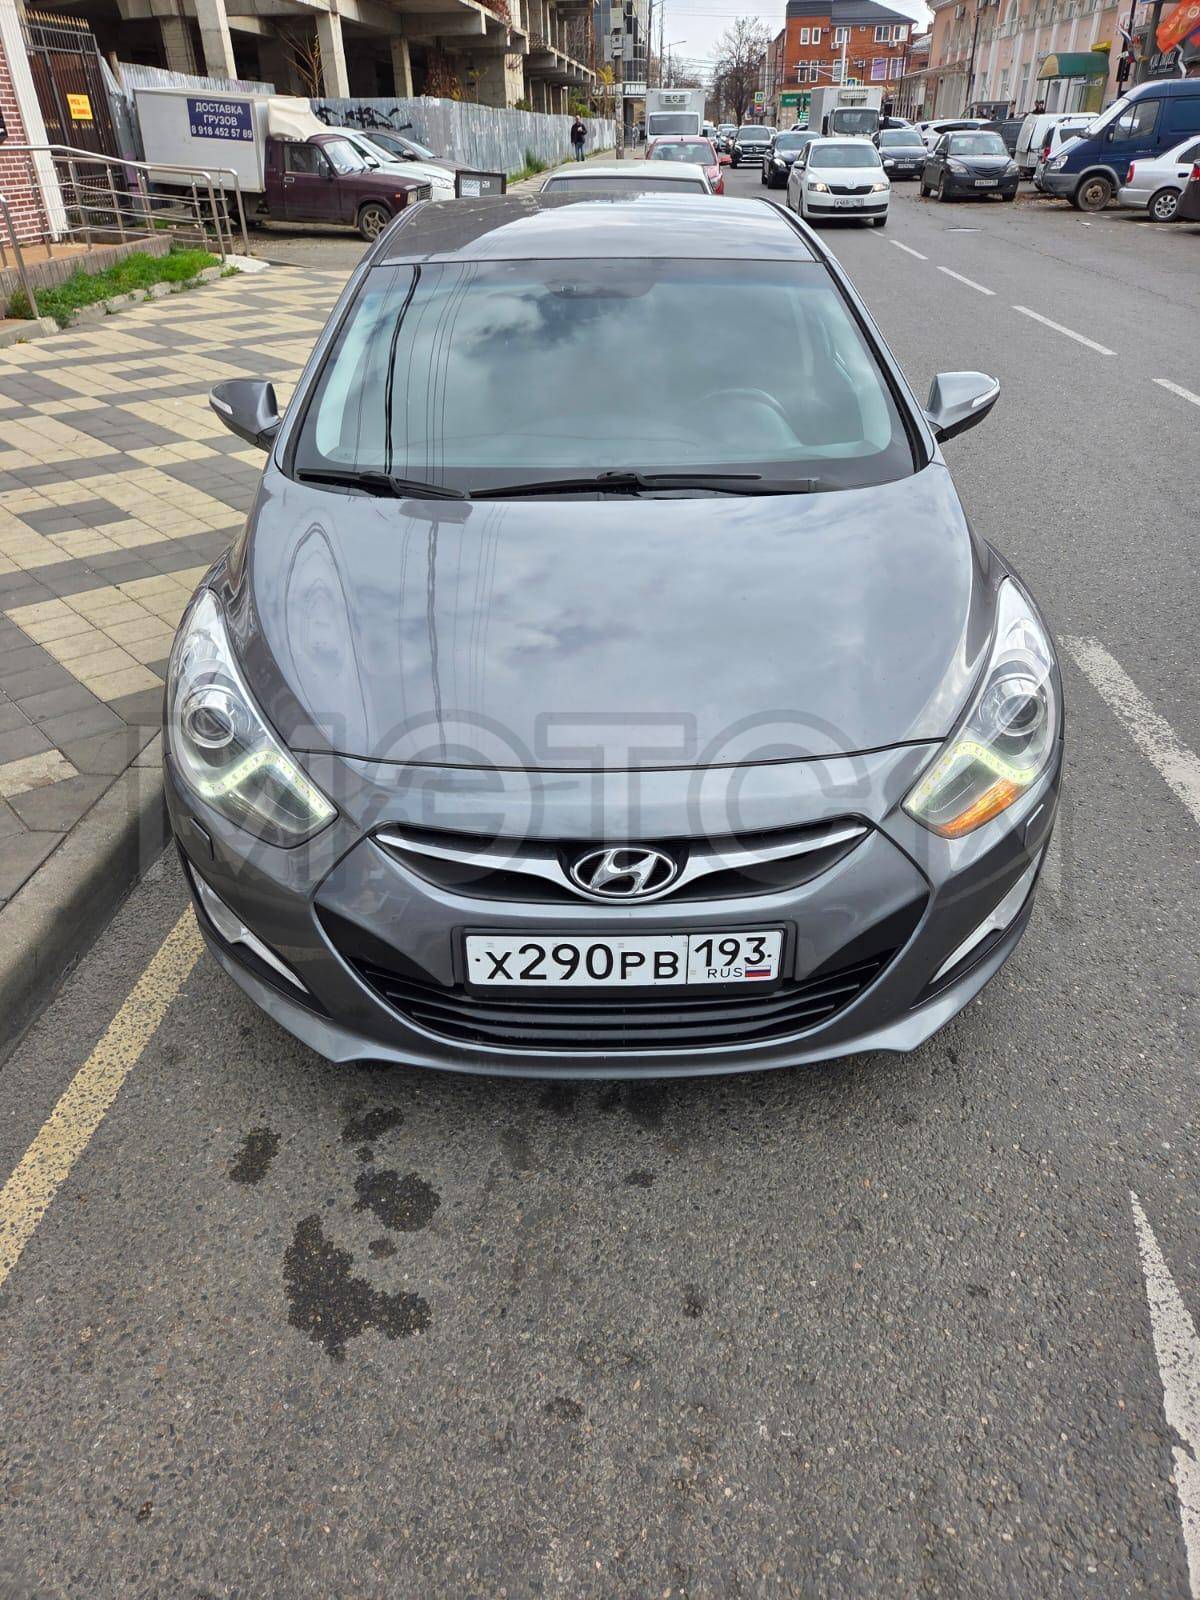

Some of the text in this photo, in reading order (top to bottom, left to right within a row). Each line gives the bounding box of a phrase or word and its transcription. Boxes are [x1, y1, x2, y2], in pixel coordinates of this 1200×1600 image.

[195, 102, 243, 115] ДОСТАВКА
[203, 114, 238, 126] ГРУЗОВ
[198, 125, 213, 136] 918
[214, 127, 230, 137] 452
[231, 128, 241, 137] 57
[694, 937, 768, 967] 193
[707, 967, 743, 979] RUS
